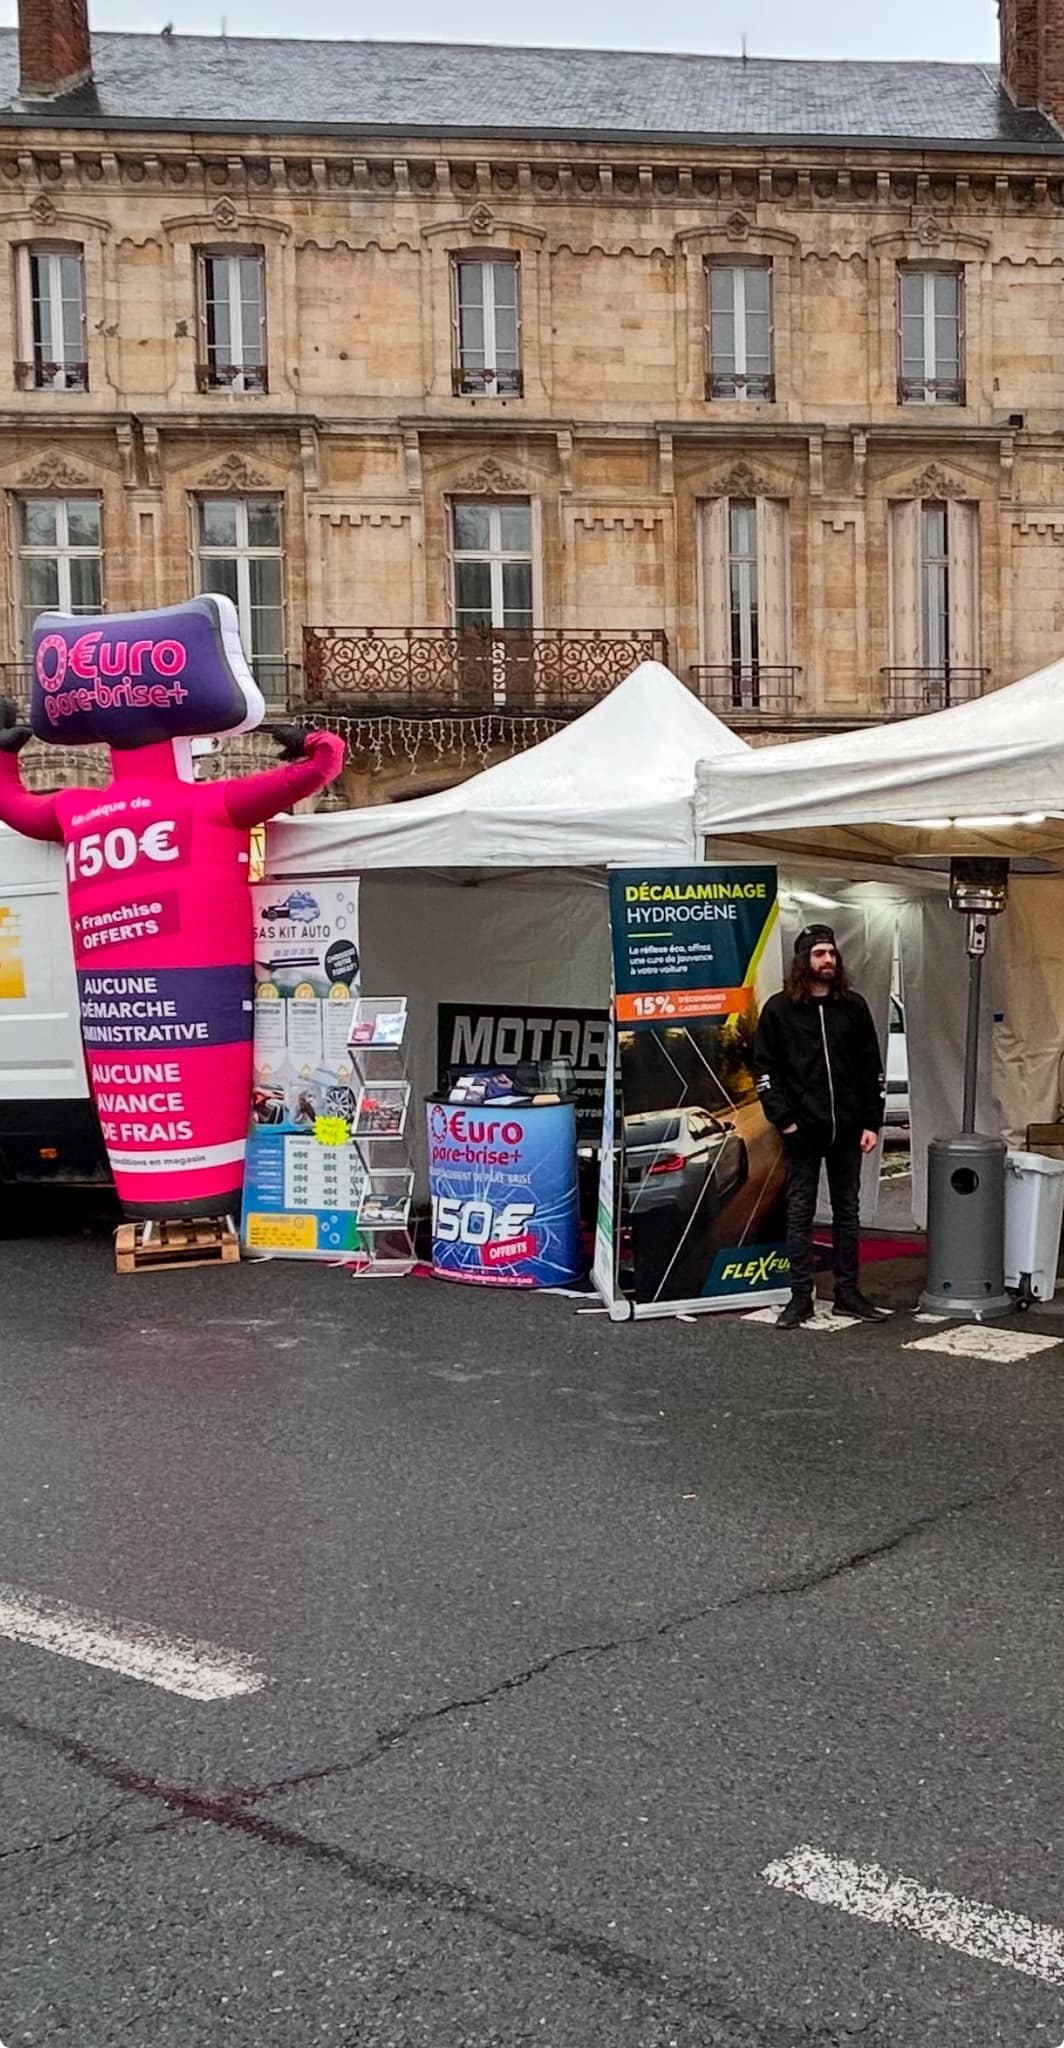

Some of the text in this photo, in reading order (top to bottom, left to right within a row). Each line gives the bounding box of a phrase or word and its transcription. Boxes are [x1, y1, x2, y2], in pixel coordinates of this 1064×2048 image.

[130, 797, 151, 809] de
[65, 820, 179, 882] 150€
[625, 882, 766, 902] DÉCALAMINAGE
[82, 902, 162, 929] Franchise
[627, 901, 737, 924] HYDROGÈNE
[83, 920, 159, 949] OFFERTS
[280, 926, 297, 938] KIT
[302, 925, 331, 938] AUTO
[628, 946, 639, 955] Le
[669, 944, 687, 953] éco,
[629, 954, 714, 965] une cure de jouvence
[630, 965, 688, 975] à votre voiture
[84, 977, 158, 994] AUCUNE
[82, 1000, 177, 1018] DÉMARCHE
[633, 994, 676, 1016] 15%
[83, 1022, 209, 1042] MINISTRATIVE
[451, 1015, 622, 1067] MOTOR
[92, 1063, 182, 1084] AUCUNE
[98, 1092, 185, 1113] AVANCE
[102, 1121, 193, 1142] DE FRAIS
[149, 1158, 161, 1166] en
[163, 1155, 206, 1166] magasin
[432, 1147, 523, 1165] pare-brise+
[489, 1242, 528, 1260] OFFERTS
